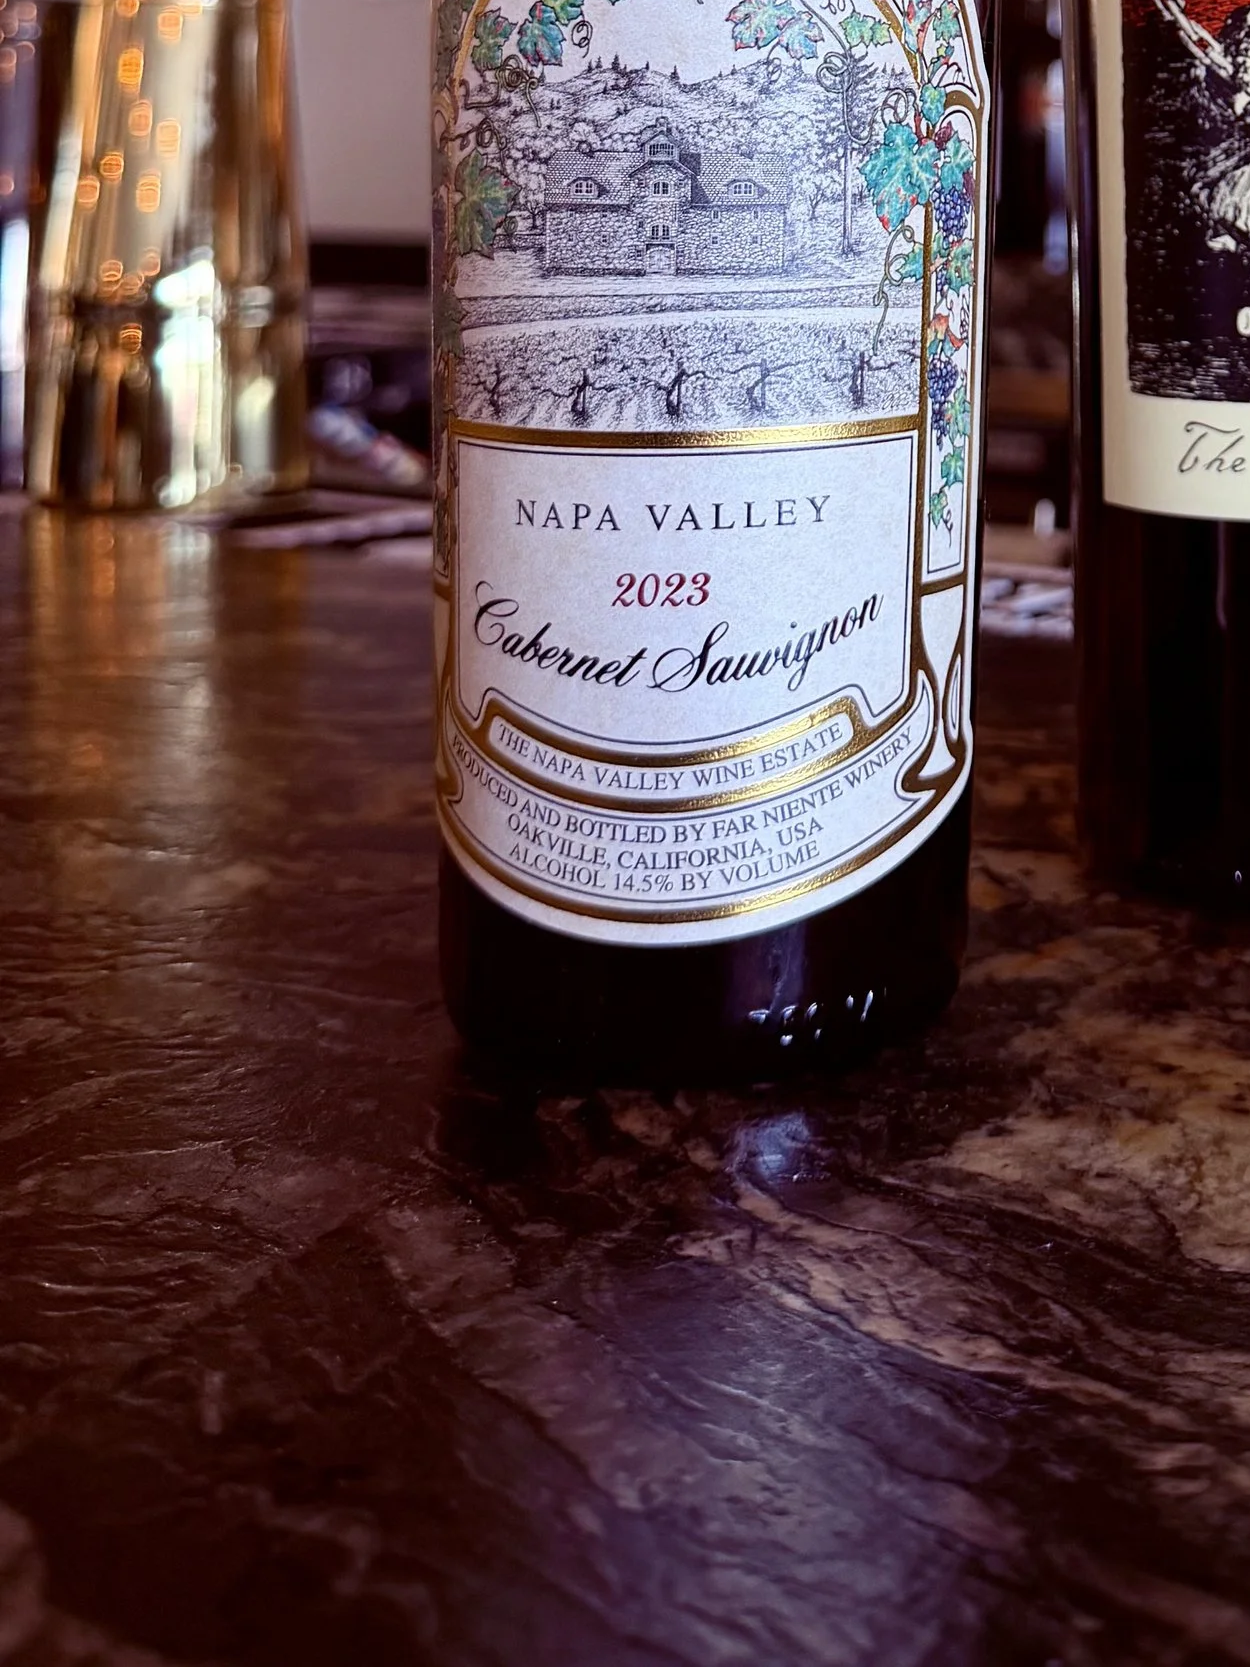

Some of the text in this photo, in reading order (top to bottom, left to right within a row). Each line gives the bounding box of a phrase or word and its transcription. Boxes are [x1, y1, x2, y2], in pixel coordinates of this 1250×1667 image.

[1178, 420, 1246, 474] The
[515, 494, 831, 532] NAPA VALLEY
[611, 571, 711, 608] 2023
[473, 580, 884, 693] Cabernet Sauvignon
[498, 722, 843, 791] THE NAPA VALLEY WINE ESTATE
[452, 727, 913, 844] PRODUCED AND BOTTLED BY FAR NIENTE WINERY
[507, 813, 824, 870] OAKVILLE, CALIFORNIA, USA
[509, 840, 820, 892] ALCOHOL 14.5% BY VOLUME
